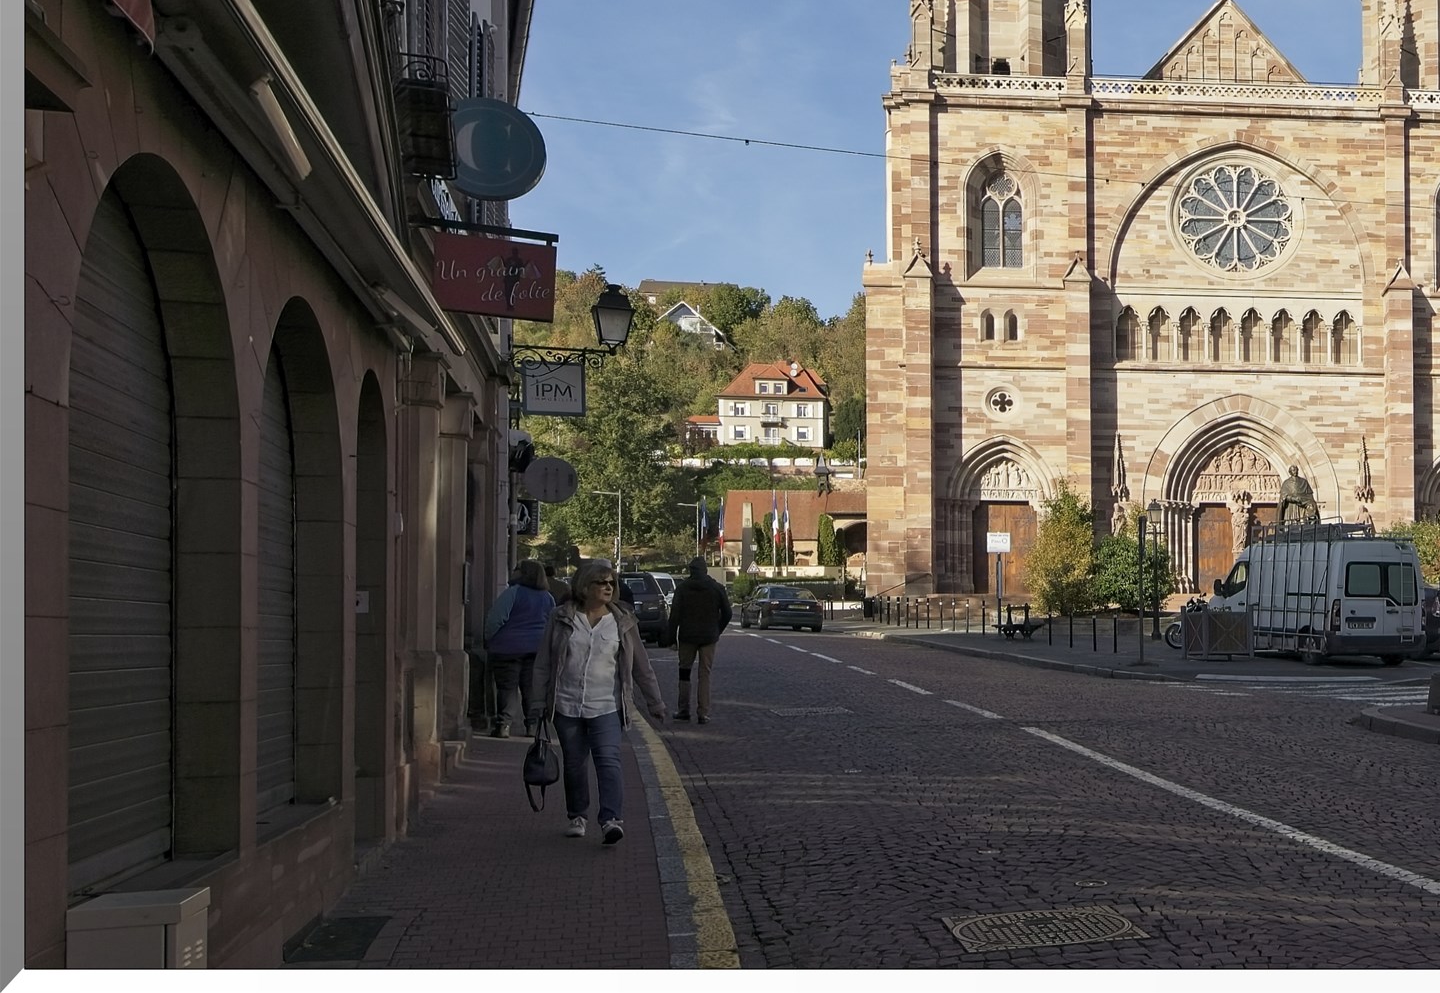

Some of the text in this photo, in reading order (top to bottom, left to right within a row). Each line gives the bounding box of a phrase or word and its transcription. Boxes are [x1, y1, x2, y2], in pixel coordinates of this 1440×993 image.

[436, 259, 526, 283] Un grain
[481, 280, 550, 306] de folie
